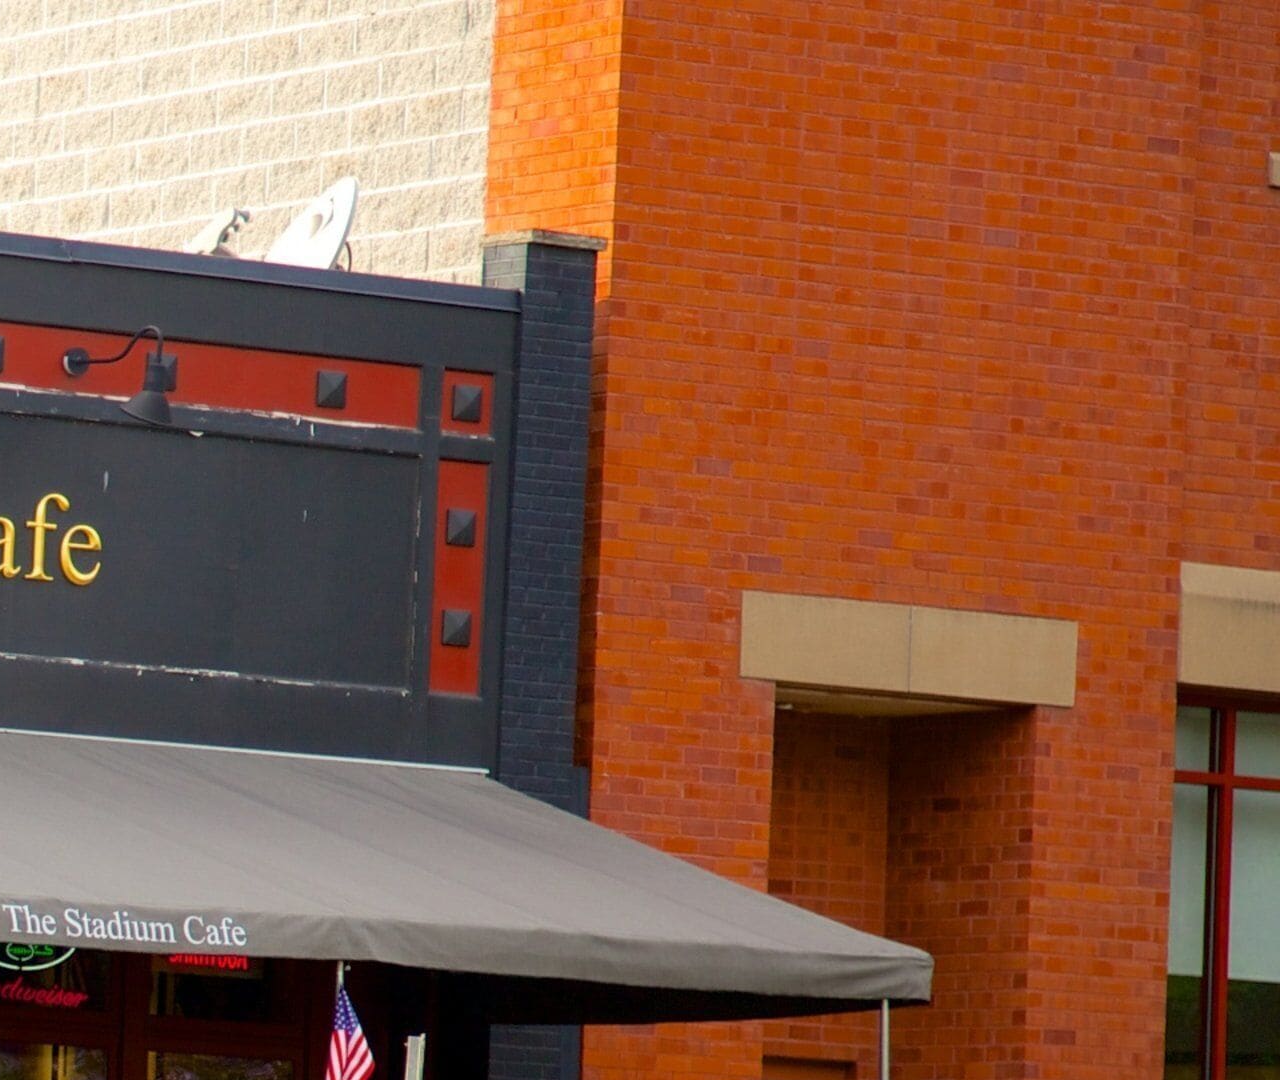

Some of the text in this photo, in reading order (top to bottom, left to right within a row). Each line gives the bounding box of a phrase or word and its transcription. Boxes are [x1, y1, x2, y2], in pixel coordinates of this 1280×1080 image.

[2, 904, 248, 946] The Stadium Cafe
